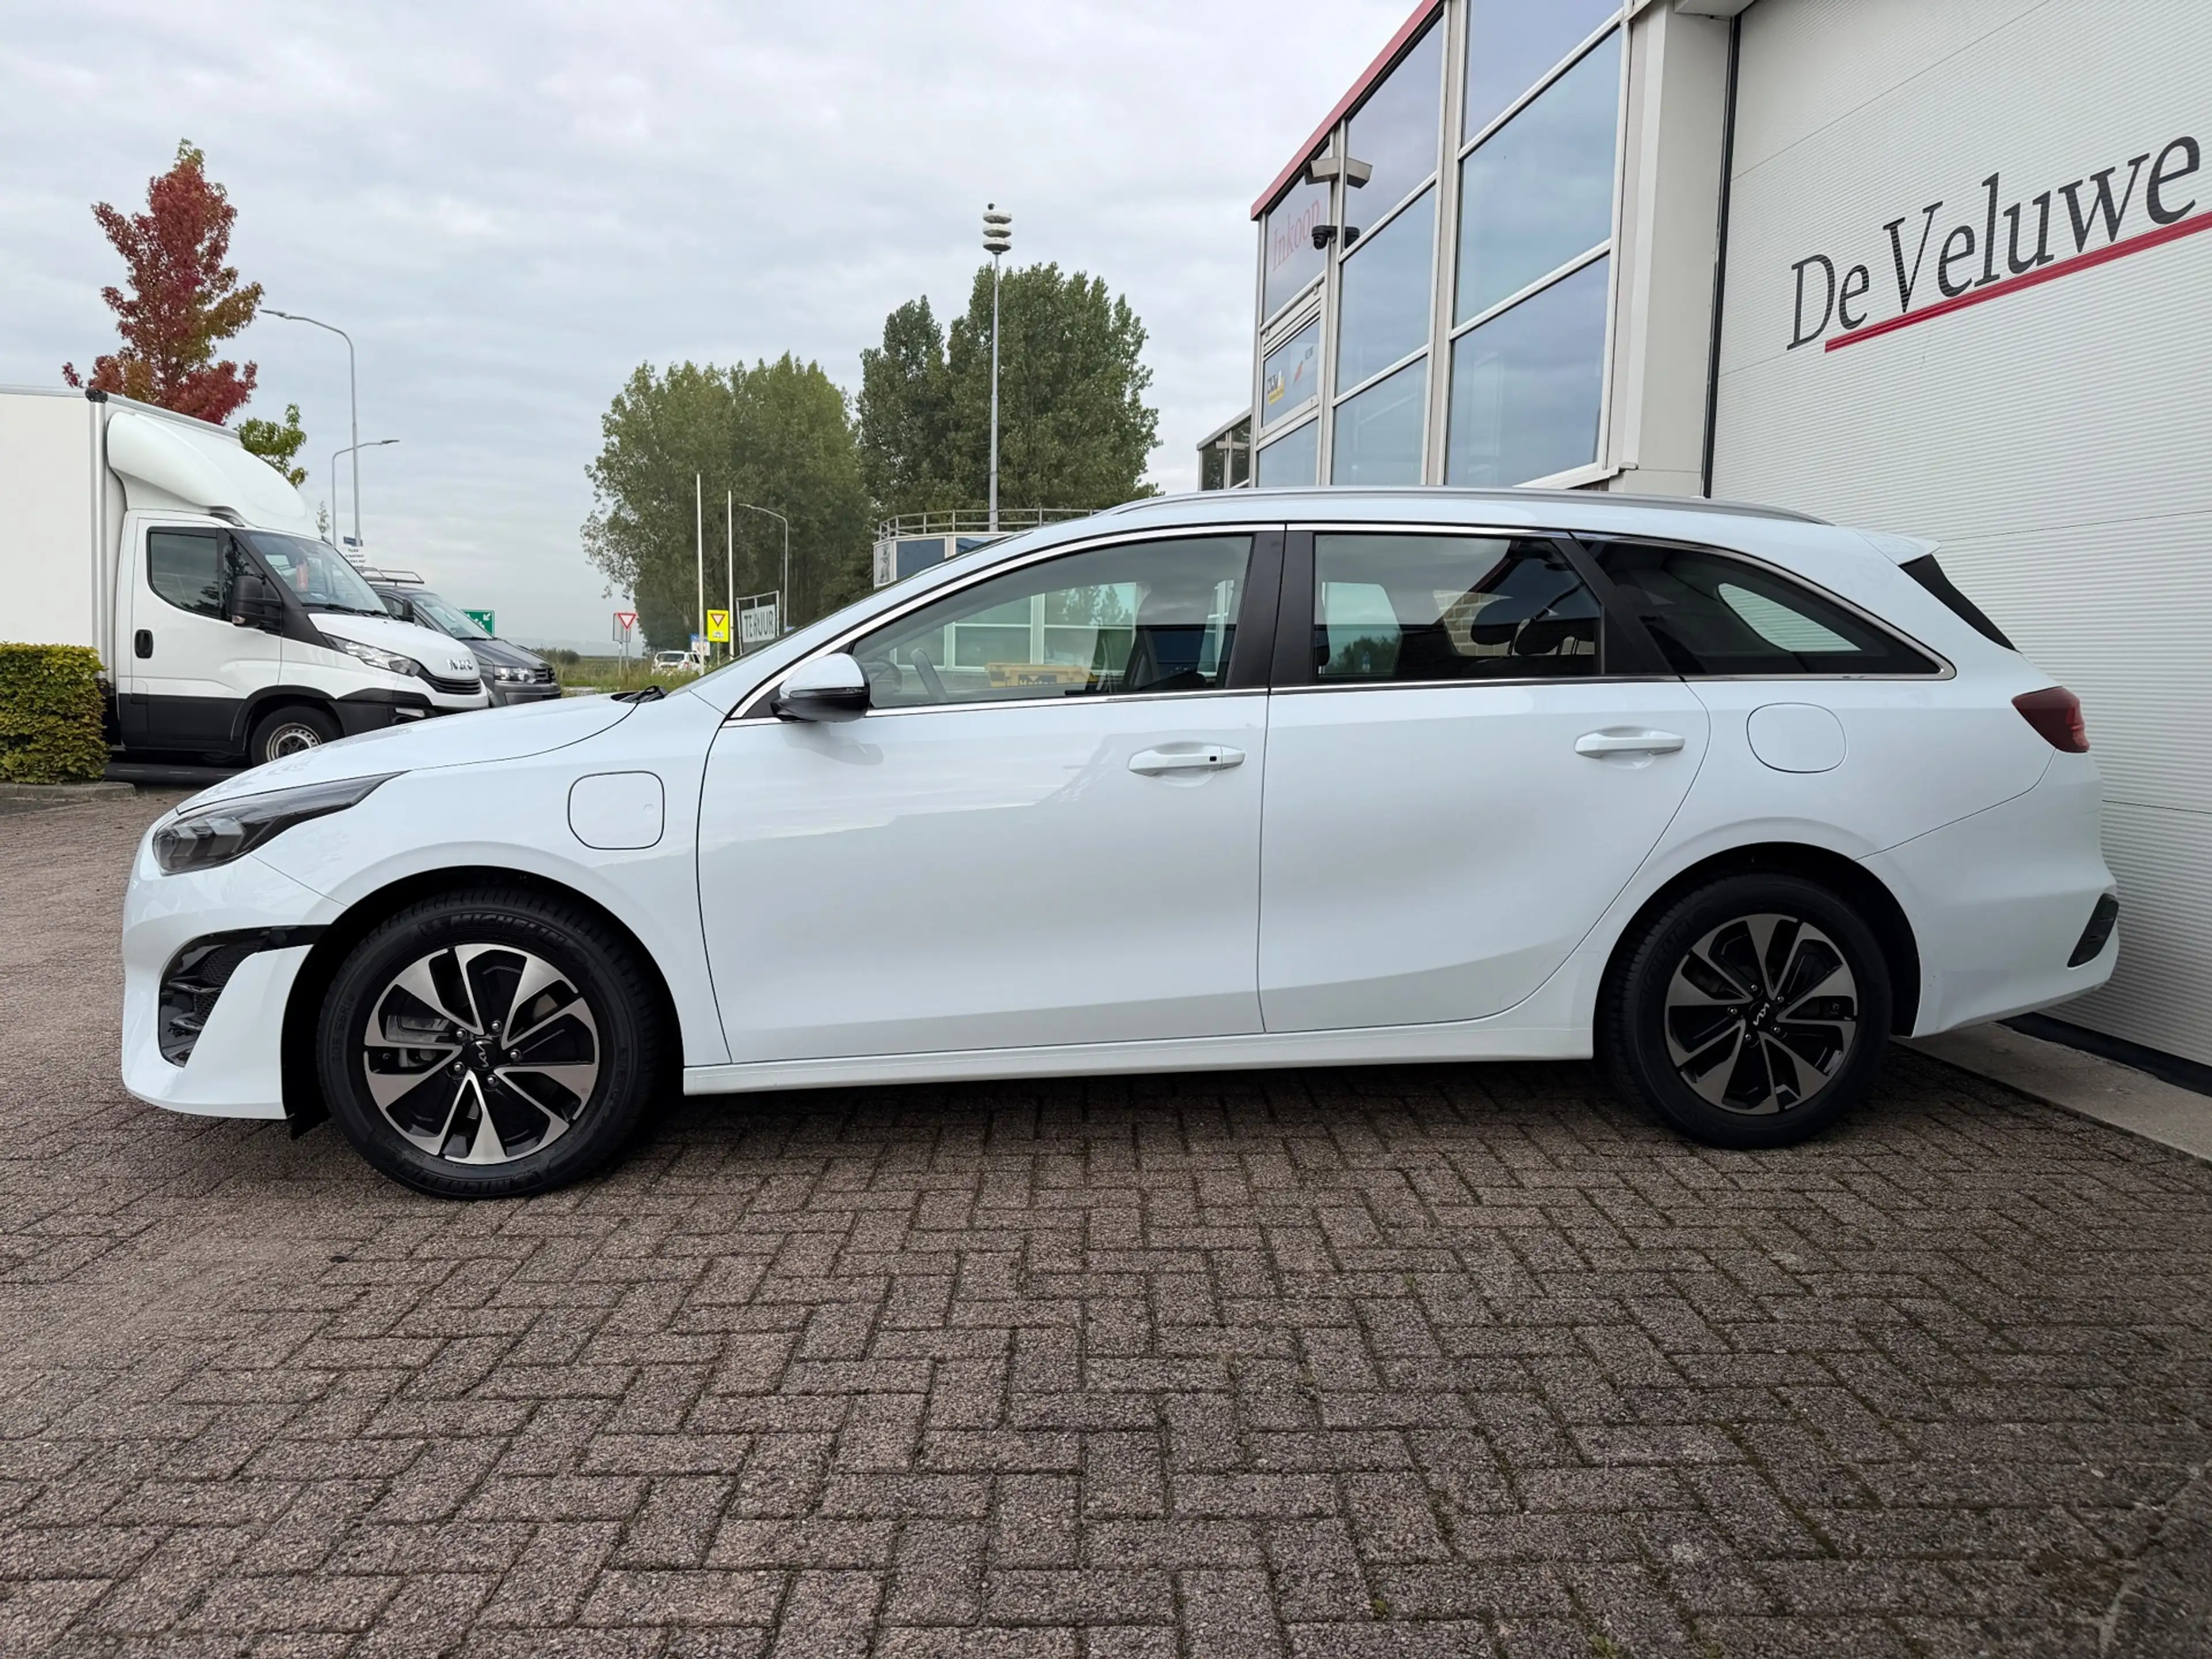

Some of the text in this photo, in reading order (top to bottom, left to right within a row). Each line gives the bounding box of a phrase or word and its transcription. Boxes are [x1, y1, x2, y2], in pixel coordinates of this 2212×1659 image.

[1272, 199, 1320, 272] Inkoop
[1787, 135, 2200, 350] De Veluwe
[450, 914, 567, 944] MICHELIN
